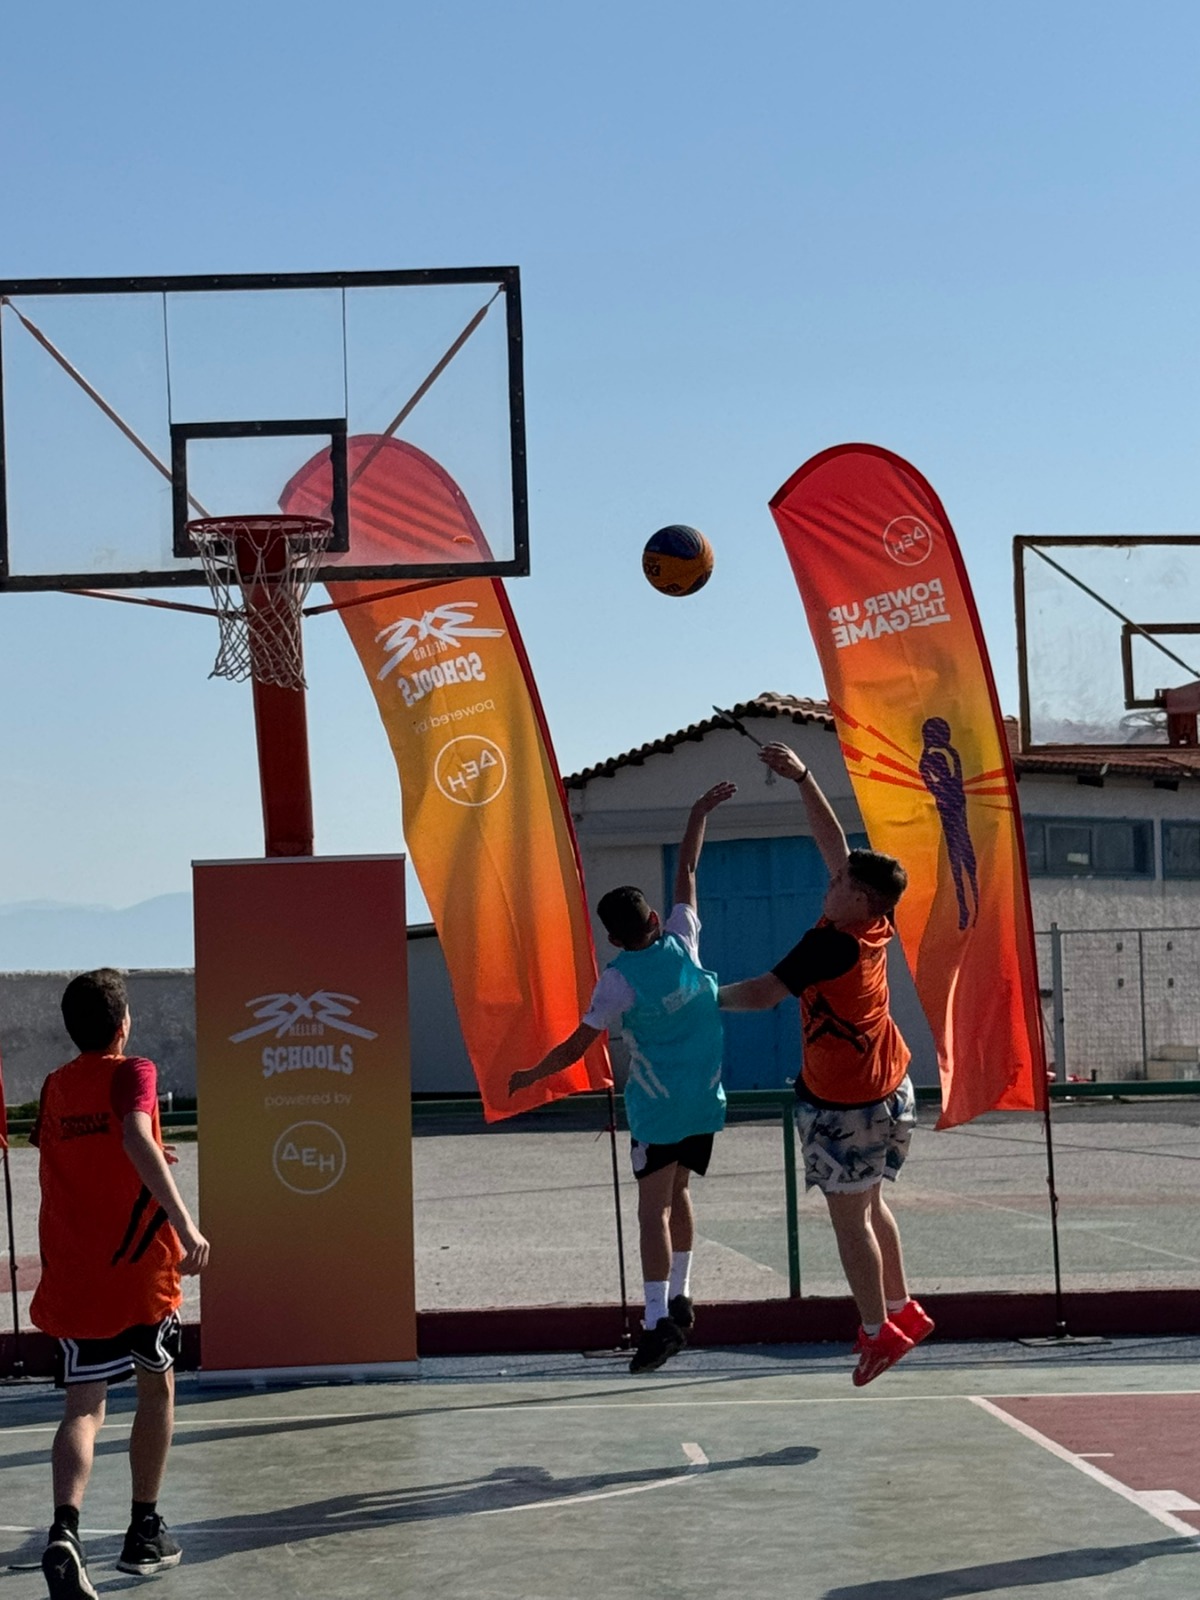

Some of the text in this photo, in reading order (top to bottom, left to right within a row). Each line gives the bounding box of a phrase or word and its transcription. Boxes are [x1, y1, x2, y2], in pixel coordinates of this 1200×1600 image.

[262, 1044, 353, 1078] SCHOOLS
[264, 1091, 352, 1110] powered by
